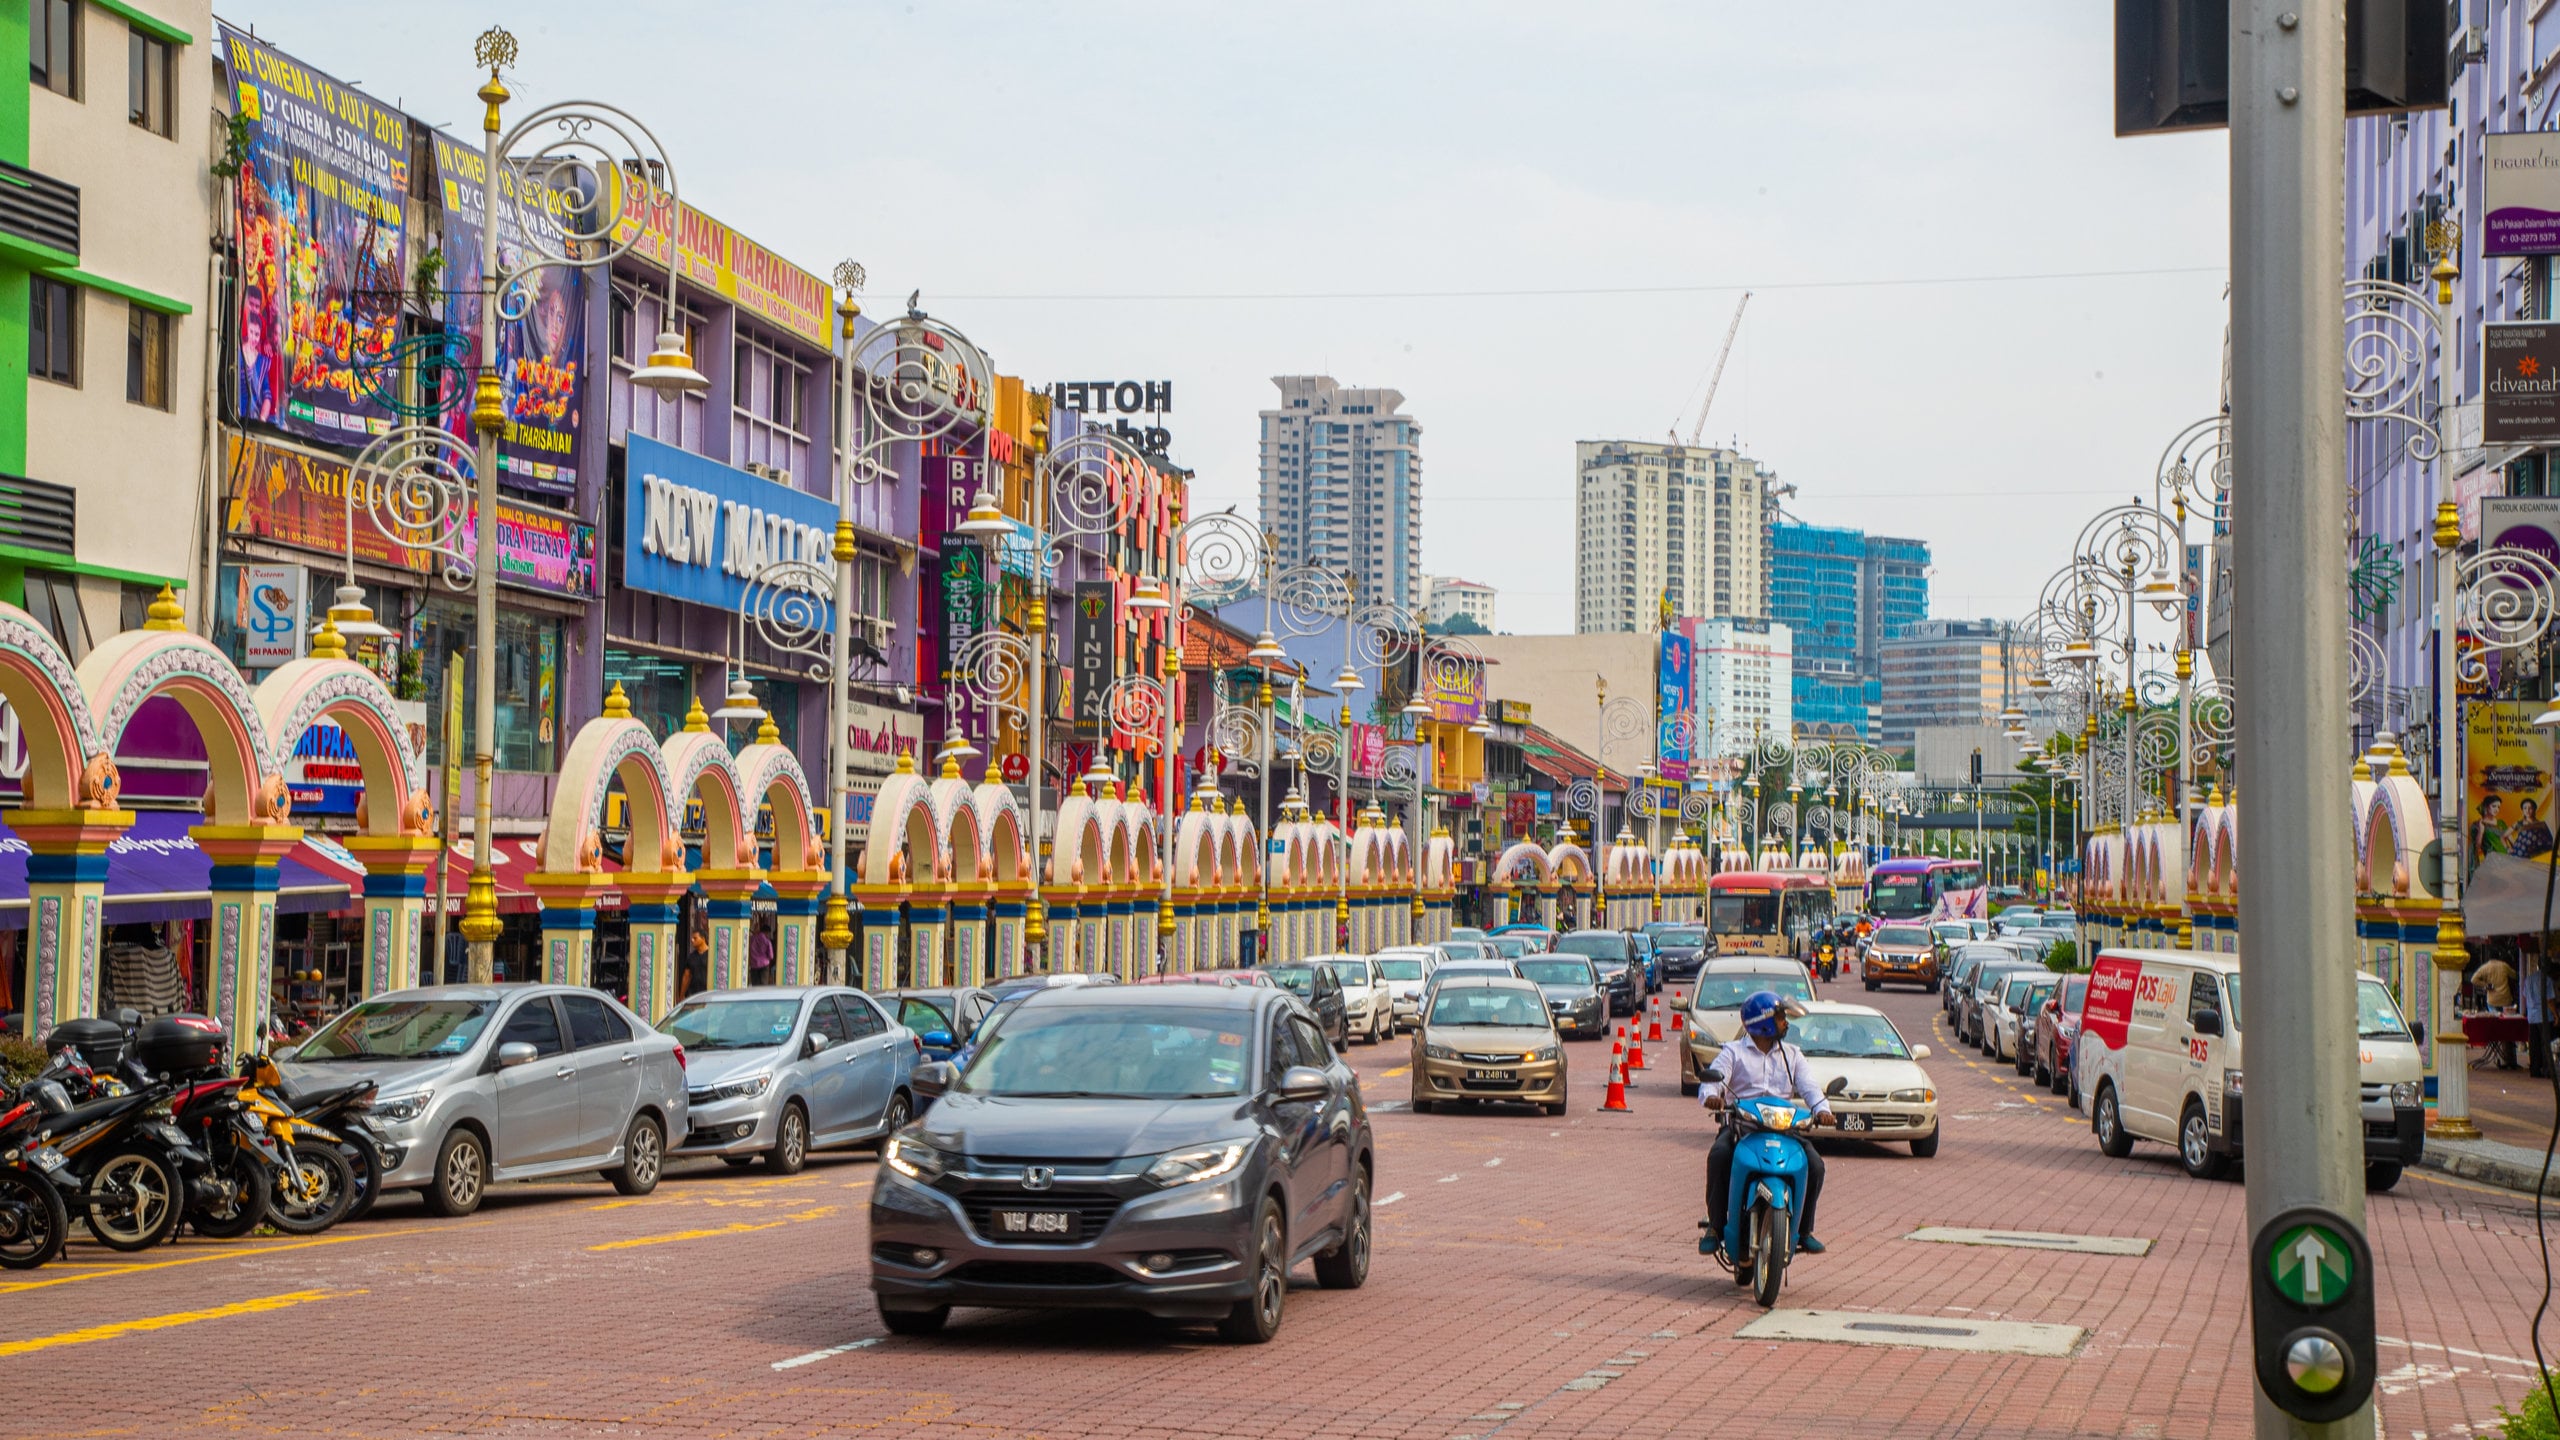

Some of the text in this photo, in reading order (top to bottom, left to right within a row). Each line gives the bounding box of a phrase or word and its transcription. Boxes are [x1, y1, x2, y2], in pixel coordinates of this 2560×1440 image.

[229, 37, 403, 151] IN CINEMA 18 JULY 2019
[281, 98, 333, 142] CINEMA
[336, 125, 361, 153] SDN
[363, 139, 389, 171] BHD
[293, 155, 315, 188] KALI
[316, 168, 339, 199] MUNI
[438, 140, 454, 172] IN
[500, 168, 514, 198] 18
[730, 233, 826, 322] MARIAMMAN
[765, 294, 792, 325] VISAGA
[793, 310, 821, 340] UBAYAM
[2498, 415, 2556, 425] www.divanah.com
[519, 424, 573, 455] THARISANAM
[989, 429, 1013, 466] OYO
[643, 474, 718, 569] NEW
[2492, 503, 2559, 513] PRODUK KECANTIKAN
[249, 647, 292, 657] SRI PAANDI
[1083, 623, 1102, 718] INDIAN
[2473, 725, 2548, 736] Sari & Pakaian
[2490, 713, 2531, 724] Menjual
[305, 763, 363, 781] CURRY HOUS
[1725, 939, 1765, 949] rapidKL
[2136, 975, 2178, 1010] POS Laju
[2190, 1038, 2208, 1062] POS
